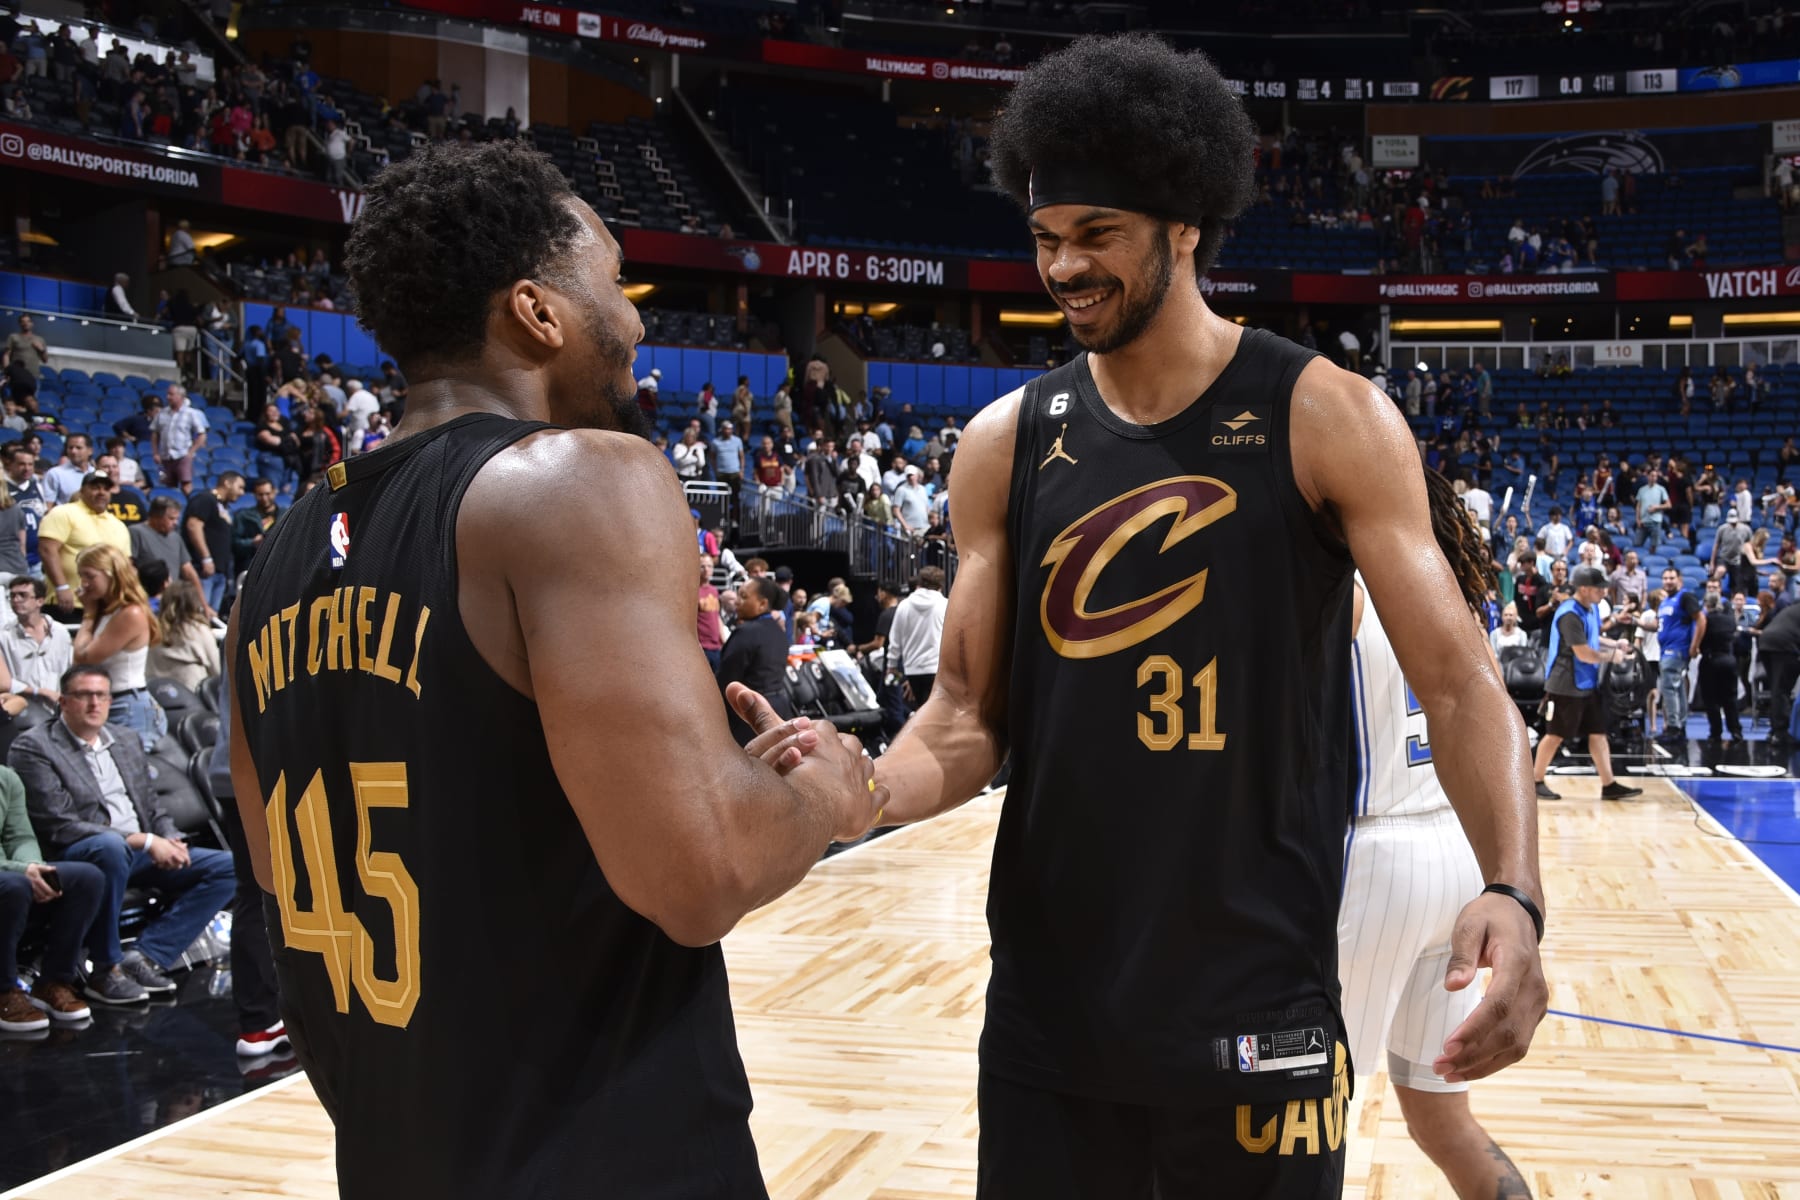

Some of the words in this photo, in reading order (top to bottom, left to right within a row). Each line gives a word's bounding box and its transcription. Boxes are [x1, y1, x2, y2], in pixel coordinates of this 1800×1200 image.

[520, 7, 542, 24] IVE
[543, 11, 561, 27] ON
[1320, 81, 1331, 98] 4
[1366, 81, 1374, 98] 1
[1504, 79, 1524, 96] 117
[1559, 77, 1582, 94] 0.0
[1593, 75, 1615, 92] 4TH
[1643, 73, 1663, 90] 113
[27, 142, 199, 187] @BALLYSPORTSFLORIDA
[787, 249, 831, 277] APR
[836, 253, 850, 278] 6
[866, 255, 944, 286] 6:30PM
[1605, 345, 1632, 358] 110
[1048, 392, 1070, 416] 6
[1211, 434, 1266, 447] CLIFFS
[107, 503, 141, 520] LE
[332, 556, 344, 568] NBA
[248, 585, 431, 714] MITCHELL
[1136, 654, 1227, 751] 31
[265, 762, 421, 1029] 45
[1236, 1075, 1349, 1155] CAV
